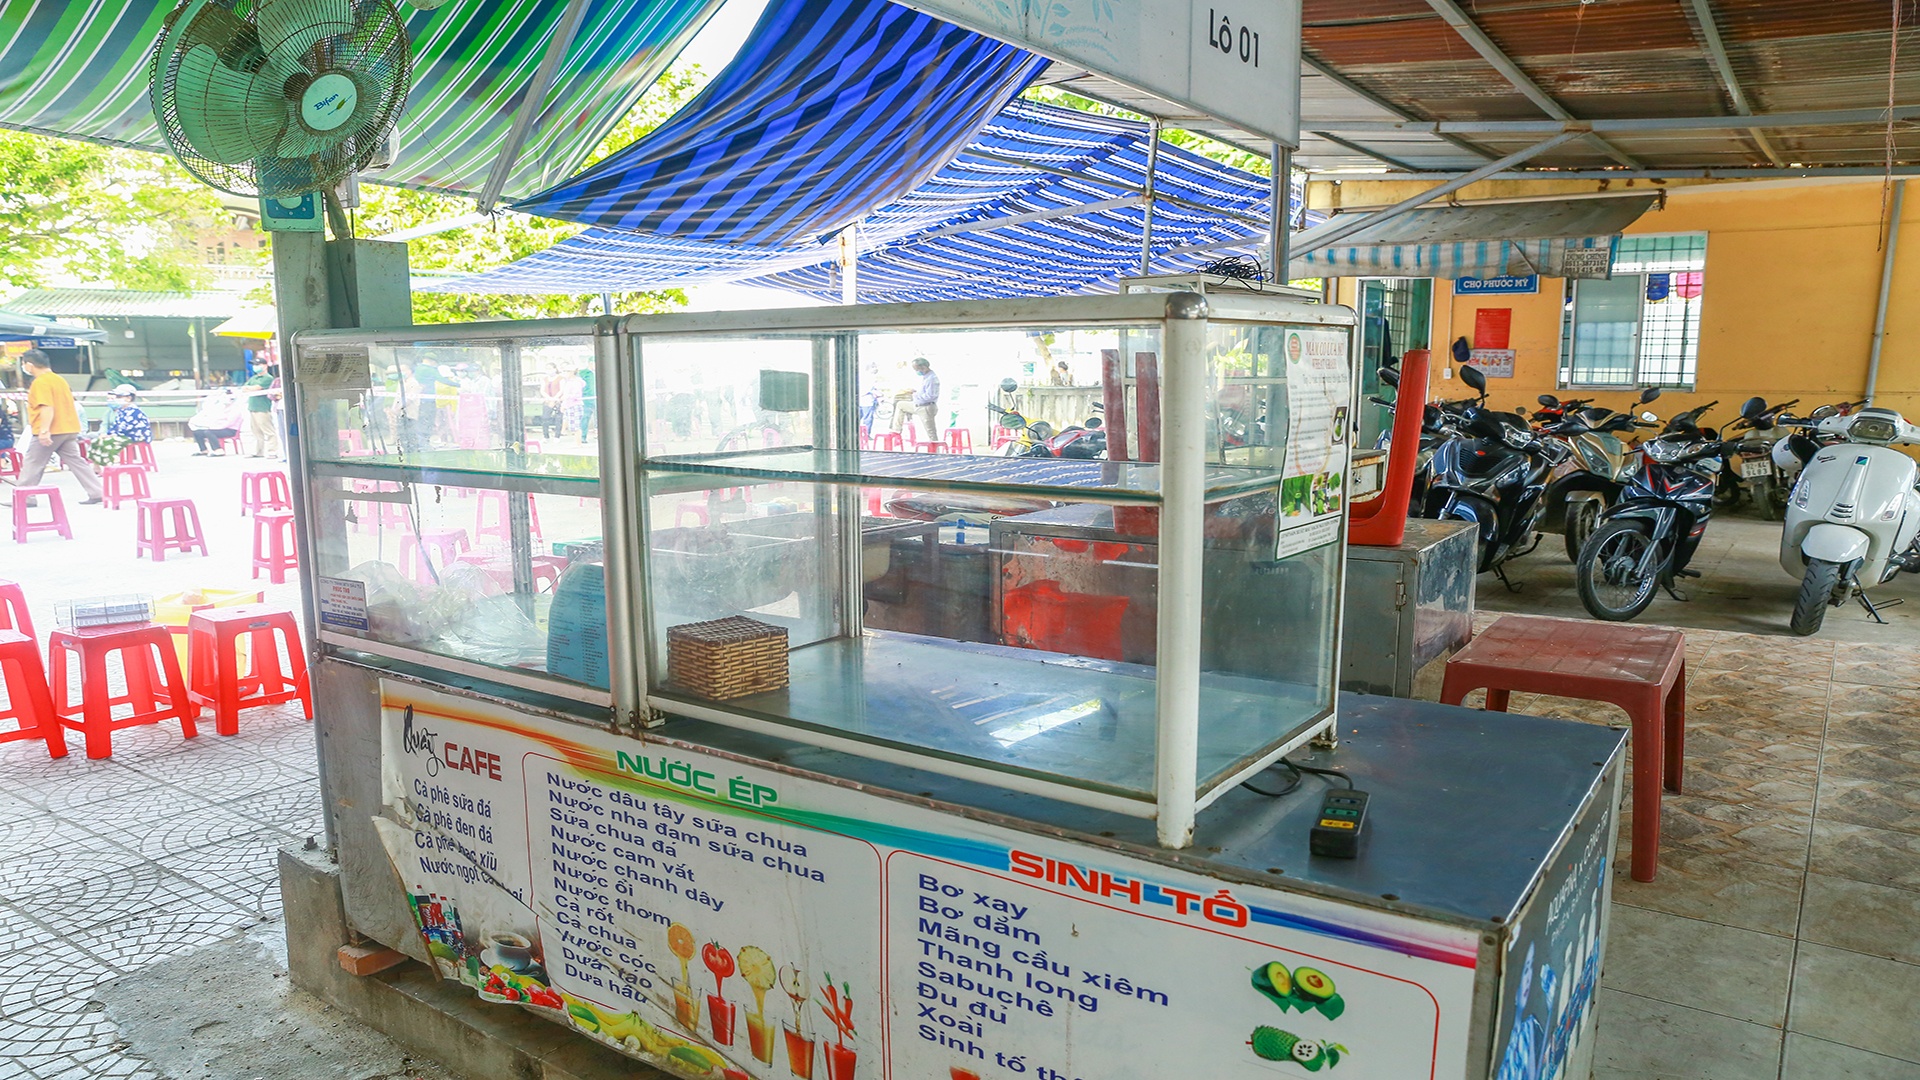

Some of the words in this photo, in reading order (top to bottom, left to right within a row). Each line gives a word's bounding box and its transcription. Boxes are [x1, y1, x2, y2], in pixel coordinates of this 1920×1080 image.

[1209, 8, 1232, 54] Lô
[1239, 26, 1259, 68] 01
[313, 93, 339, 110] Bifan
[444, 742, 502, 782] CAFE
[616, 750, 716, 794] NƯỚC
[729, 776, 778, 805] ÉP
[414, 778, 428, 798] Cà
[430, 785, 450, 805] phê
[453, 794, 474, 813] sữa
[477, 800, 492, 819] đá
[547, 772, 602, 798] Nước
[609, 791, 647, 811] dâu
[653, 803, 685, 824] tây
[692, 819, 737, 838] sữa
[746, 832, 807, 857] chua
[415, 831, 434, 849] Cà
[416, 803, 431, 824] Cà
[433, 811, 453, 830] phê
[455, 817, 476, 838] đen
[478, 825, 493, 845] đá
[549, 790, 604, 816] Nước
[611, 810, 648, 830] nha
[655, 822, 700, 846] đam
[708, 842, 754, 862] sữa
[763, 856, 825, 883] chua
[550, 807, 589, 829] Sữa
[596, 824, 645, 847] chua
[652, 840, 677, 858] đá
[419, 856, 455, 875] Nước
[456, 863, 480, 885] ngọt
[551, 825, 606, 852] Nước
[613, 847, 656, 868] cam
[662, 863, 695, 882] vắt
[552, 842, 607, 870] Nước
[614, 865, 678, 894] chanh
[685, 888, 724, 912] dây
[553, 859, 609, 888] Nước
[615, 879, 634, 897] ổi
[919, 873, 964, 898] Bơ
[973, 892, 1028, 920] xay
[1011, 849, 1141, 905] SINH
[1162, 889, 1247, 928] TỐ
[554, 877, 610, 905] Nước
[615, 899, 671, 928] thơm
[555, 895, 580, 913] Cà
[587, 908, 615, 925] rốt
[919, 895, 964, 920] Bơ
[556, 912, 582, 930] Cà
[587, 925, 637, 950] chua
[565, 963, 603, 988] Dưa
[618, 968, 653, 990] táo
[619, 955, 656, 974] cóc
[917, 938, 1013, 983] Thanh
[1026, 972, 1098, 1013] long
[919, 917, 1000, 959] Mãng
[1012, 950, 1070, 978] cầu
[1082, 970, 1169, 1007] xiêm
[916, 982, 958, 1008] Đu
[968, 1002, 1007, 1024] đủ
[918, 961, 1054, 1017] Sabuchê
[917, 1002, 983, 1038] Xoài
[918, 1024, 985, 1059] Sinh
[995, 1052, 1027, 1073] tố
